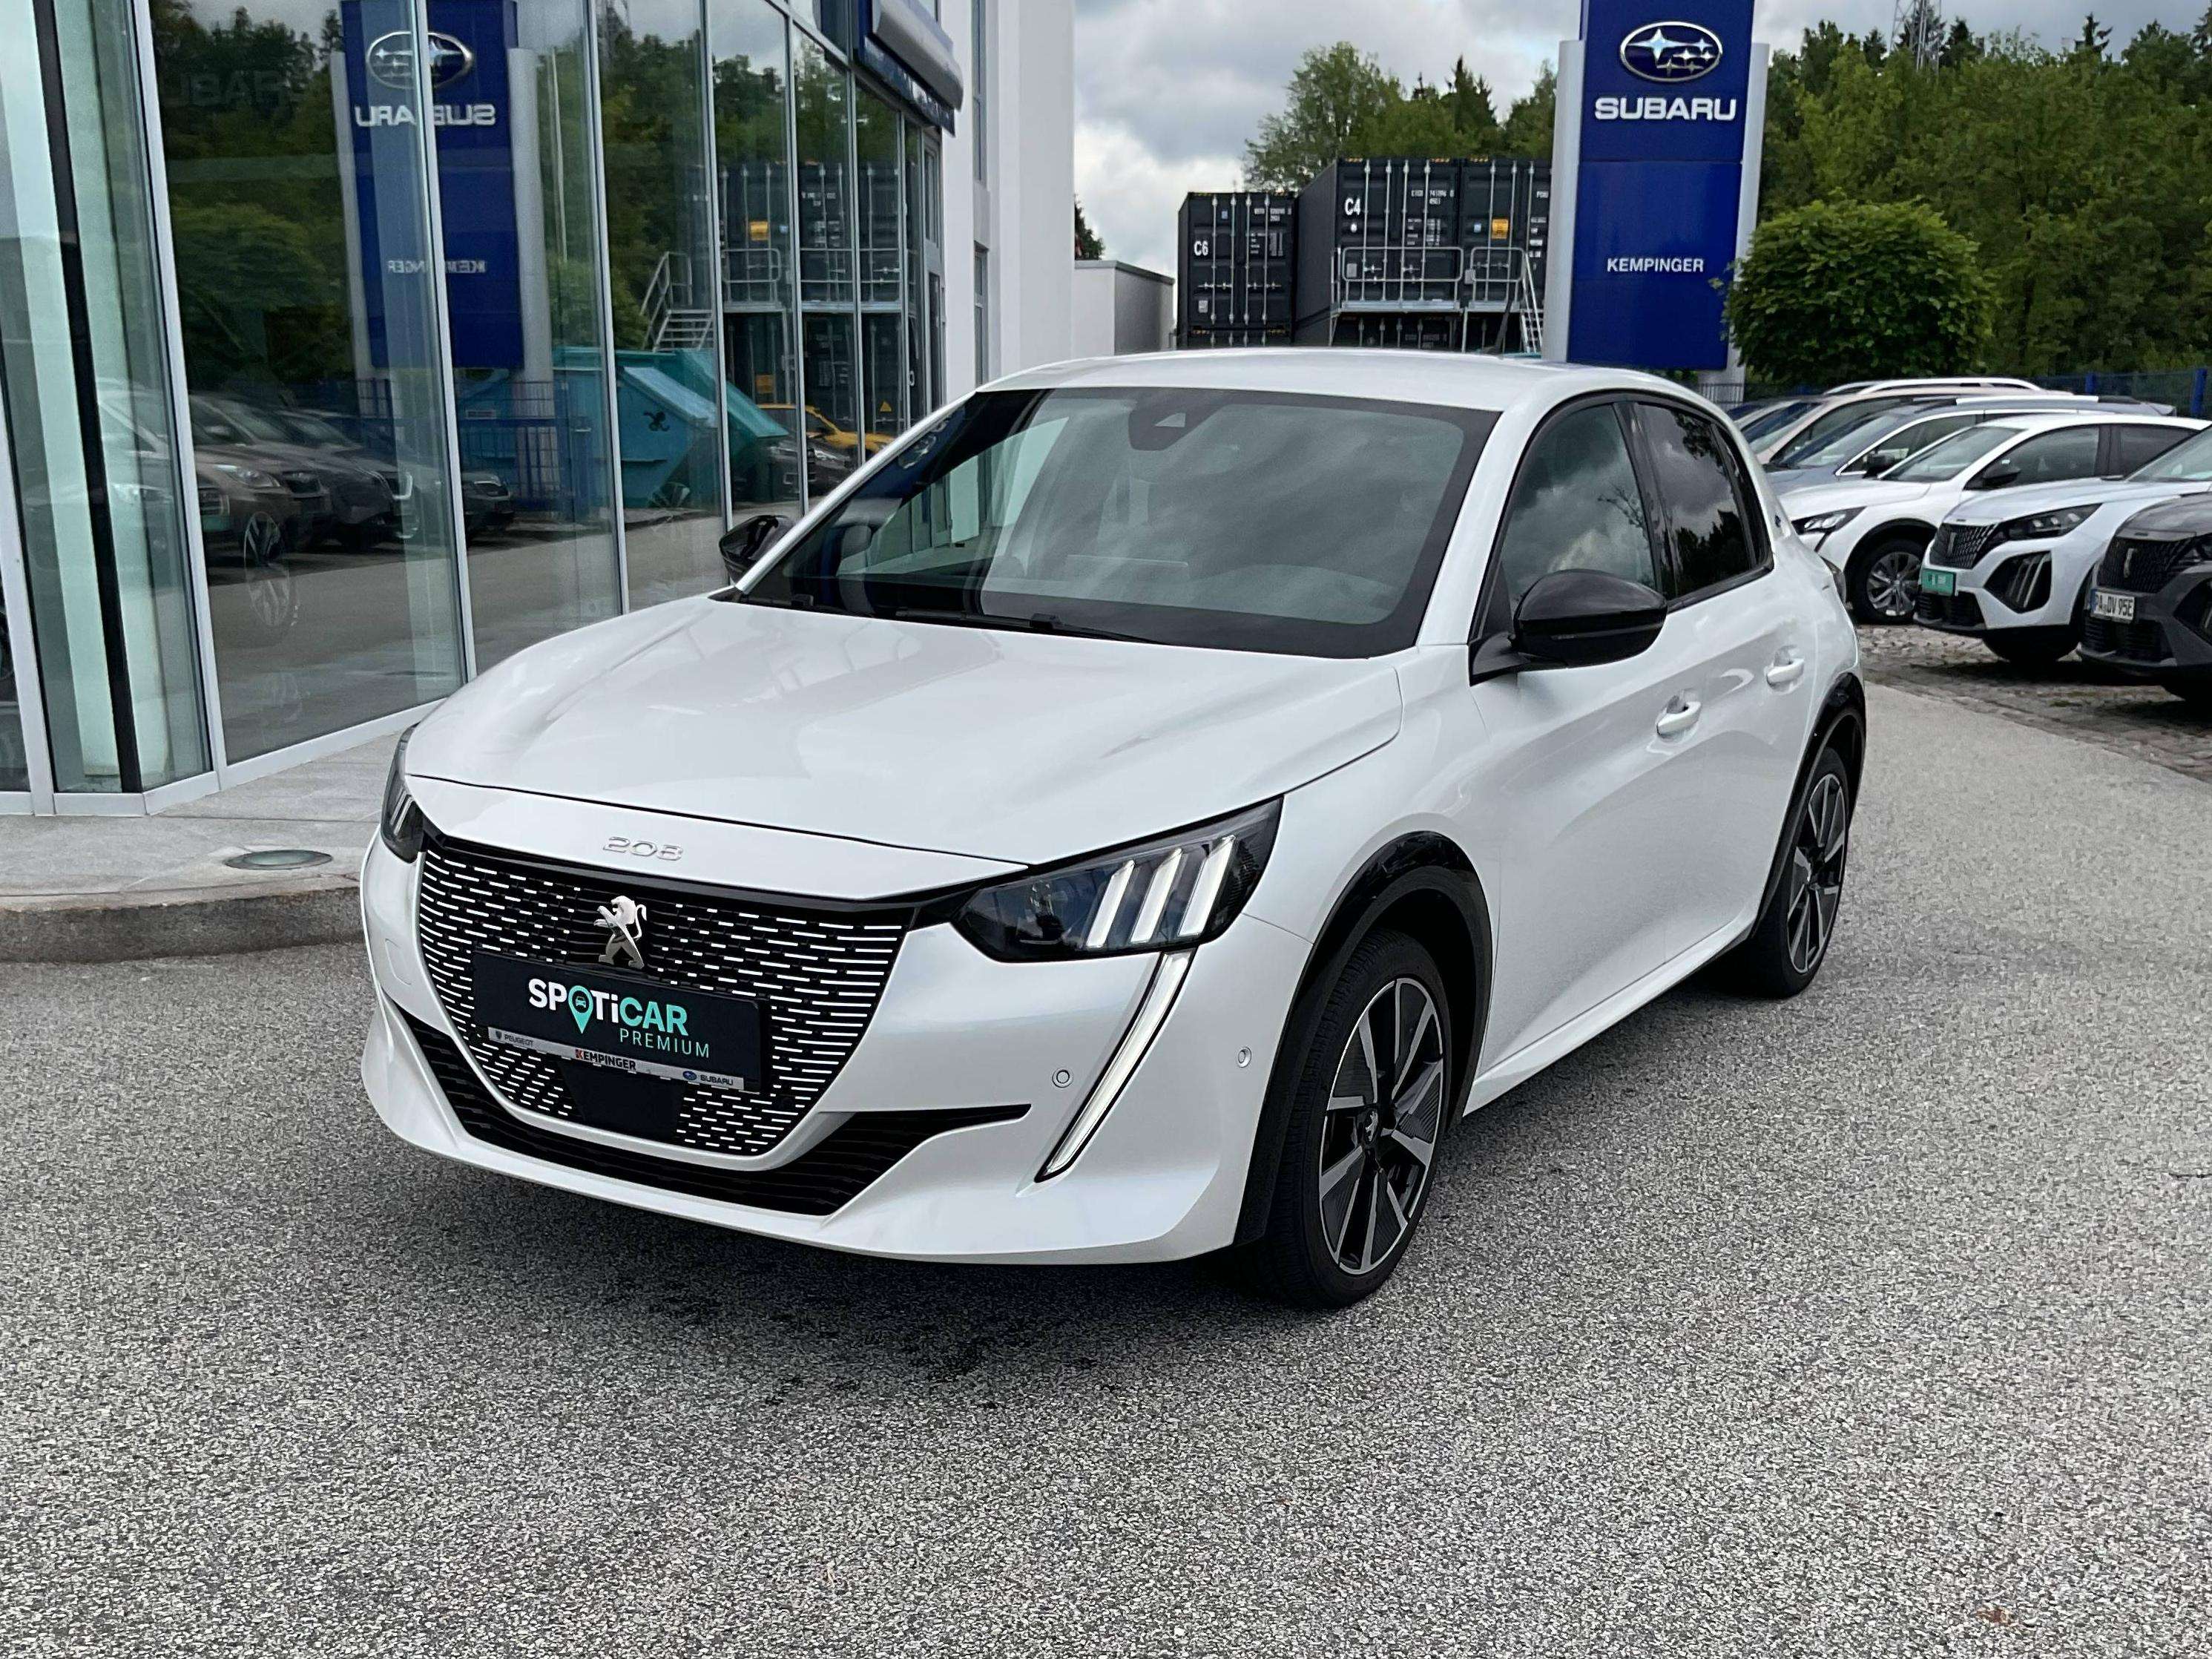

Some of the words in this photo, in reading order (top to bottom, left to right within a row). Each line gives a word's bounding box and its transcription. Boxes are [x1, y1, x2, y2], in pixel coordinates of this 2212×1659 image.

[1595, 97, 1737, 121] SUBARU
[1345, 197, 1361, 215] C4
[1194, 240, 1208, 256] C6
[1607, 258, 1704, 273] KEMPINGER
[603, 836, 683, 861] 208
[504, 1034, 534, 1047] PEUGEOT
[619, 1028, 709, 1059] PREMIUM
[575, 1048, 636, 1070] KEMPINGER
[700, 1074, 734, 1085] SUBARU
